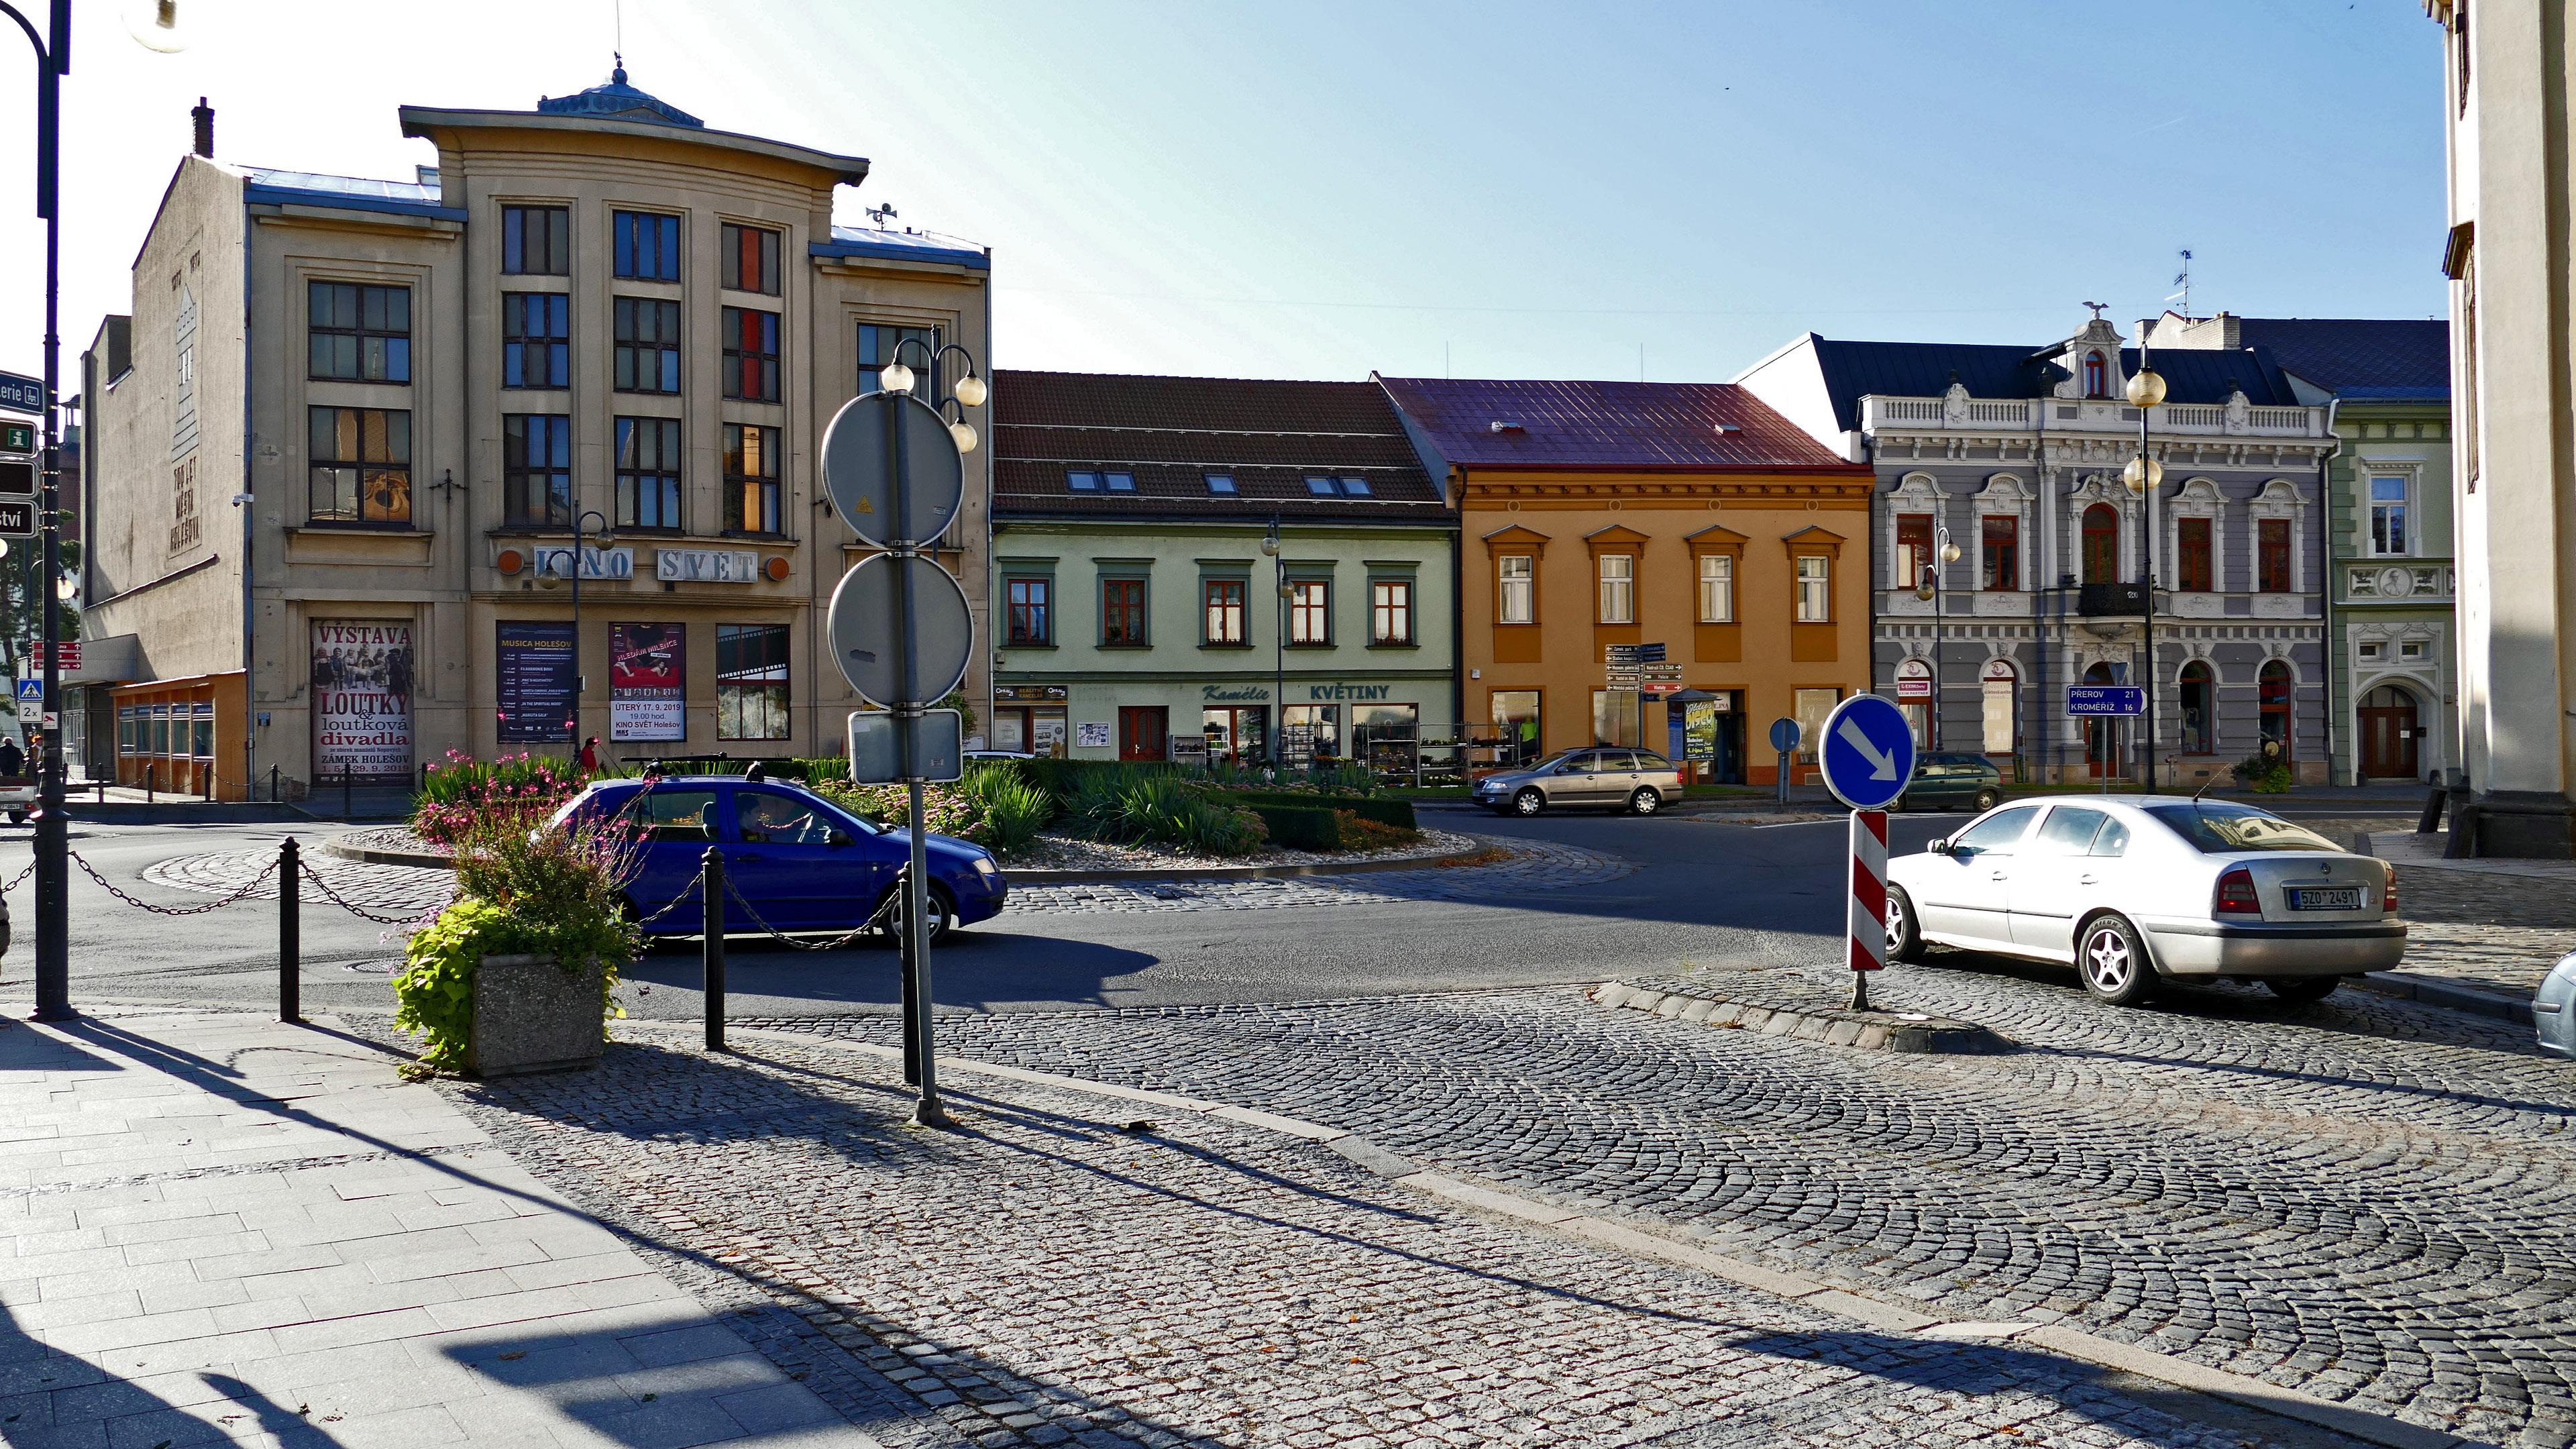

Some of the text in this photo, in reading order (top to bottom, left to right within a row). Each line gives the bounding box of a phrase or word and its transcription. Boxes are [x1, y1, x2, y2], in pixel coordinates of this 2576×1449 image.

[0, 383, 21, 401] erie
[174, 456, 197, 492] 700 LET
[176, 488, 194, 520] MĚSTA
[662, 551, 753, 582] SVĚT
[318, 622, 413, 645] VÝSTAVA
[535, 639, 572, 648] HOLEŠOV
[647, 639, 678, 653] MILENCE
[1201, 685, 1270, 700] Kamélie
[1310, 682, 1389, 700] KVĚTINY
[2071, 689, 2104, 698] PŘEROV
[321, 692, 409, 716] LOUTKY
[615, 702, 641, 711] ÚTERÝ
[1686, 702, 1712, 715] Oldies
[2071, 702, 2114, 710] KROMĚŘÍŽ
[359, 708, 373, 720] &
[321, 718, 409, 731] loutková
[320, 732, 409, 745] divadla
[322, 753, 409, 763] ZÁMEK HOLEŠOV
[2301, 891, 2322, 904] 5Z0
[2329, 891, 2354, 904] 2491
